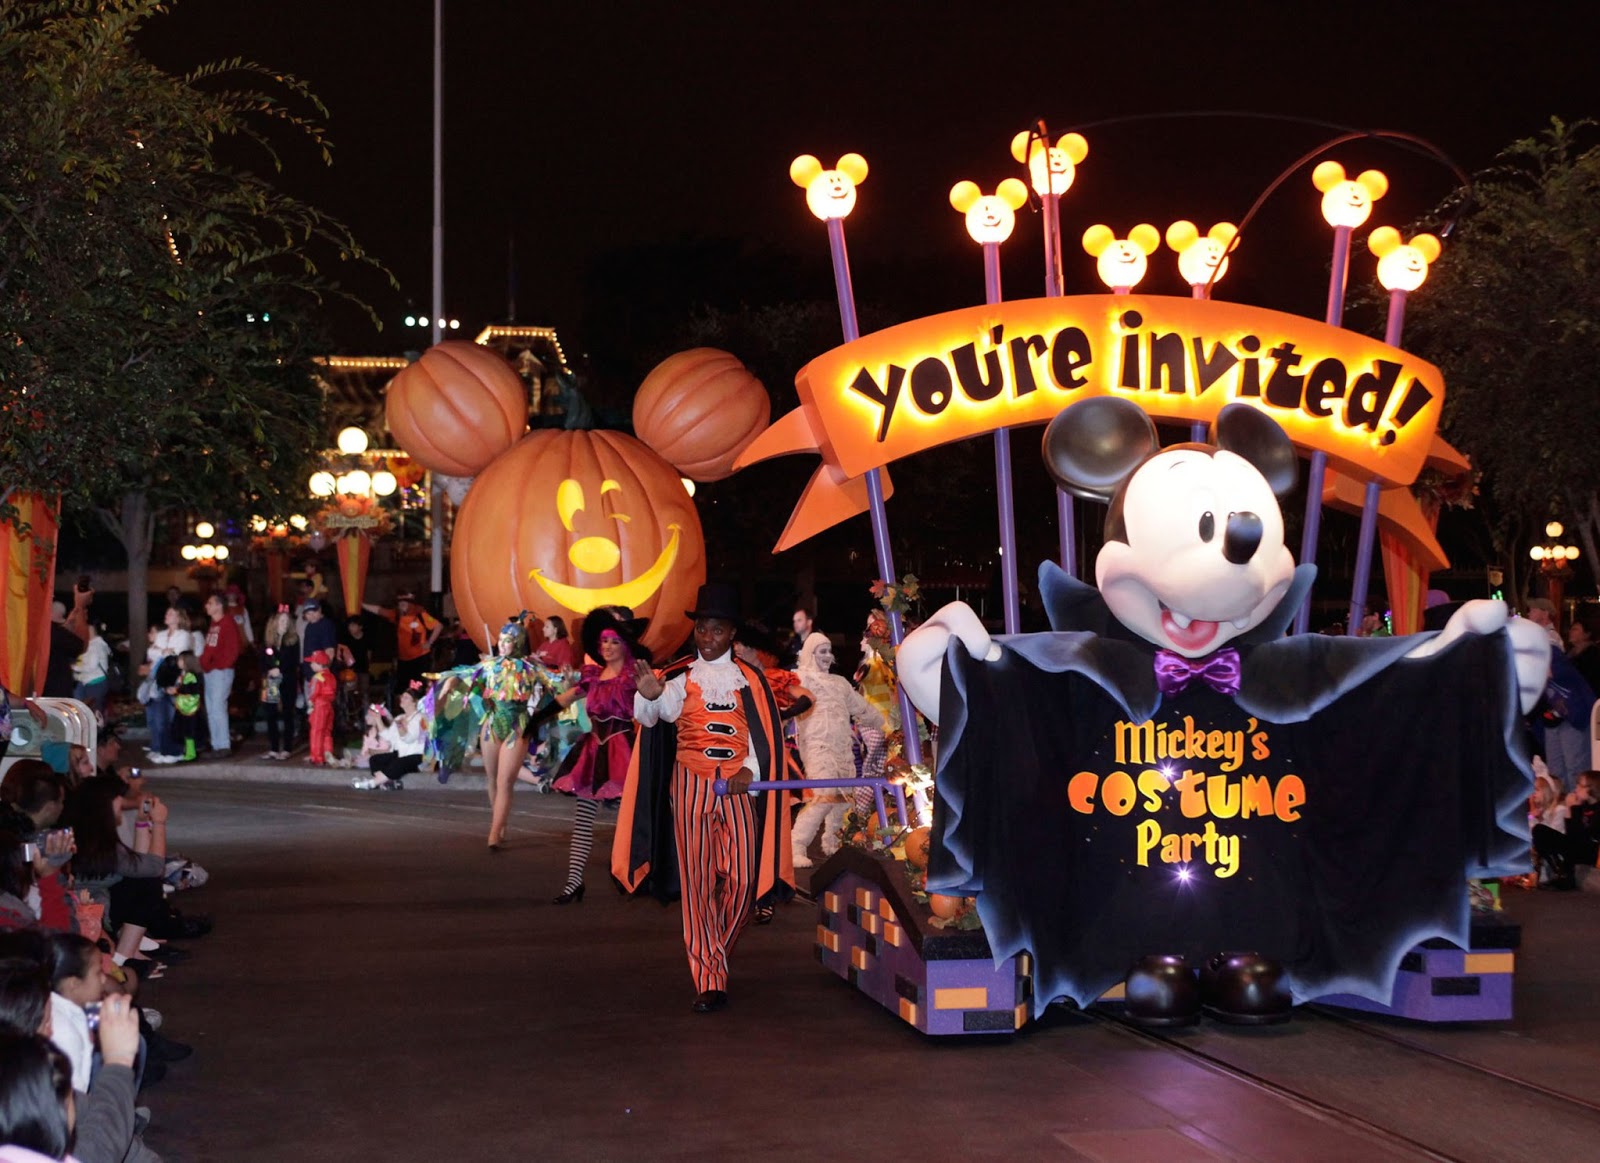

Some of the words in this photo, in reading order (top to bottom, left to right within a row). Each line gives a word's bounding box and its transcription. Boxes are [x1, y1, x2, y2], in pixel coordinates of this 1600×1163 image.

[1118, 310, 1434, 446] invited!
[1114, 715, 1271, 772] Mickey's
[1136, 818, 1240, 879] Party
